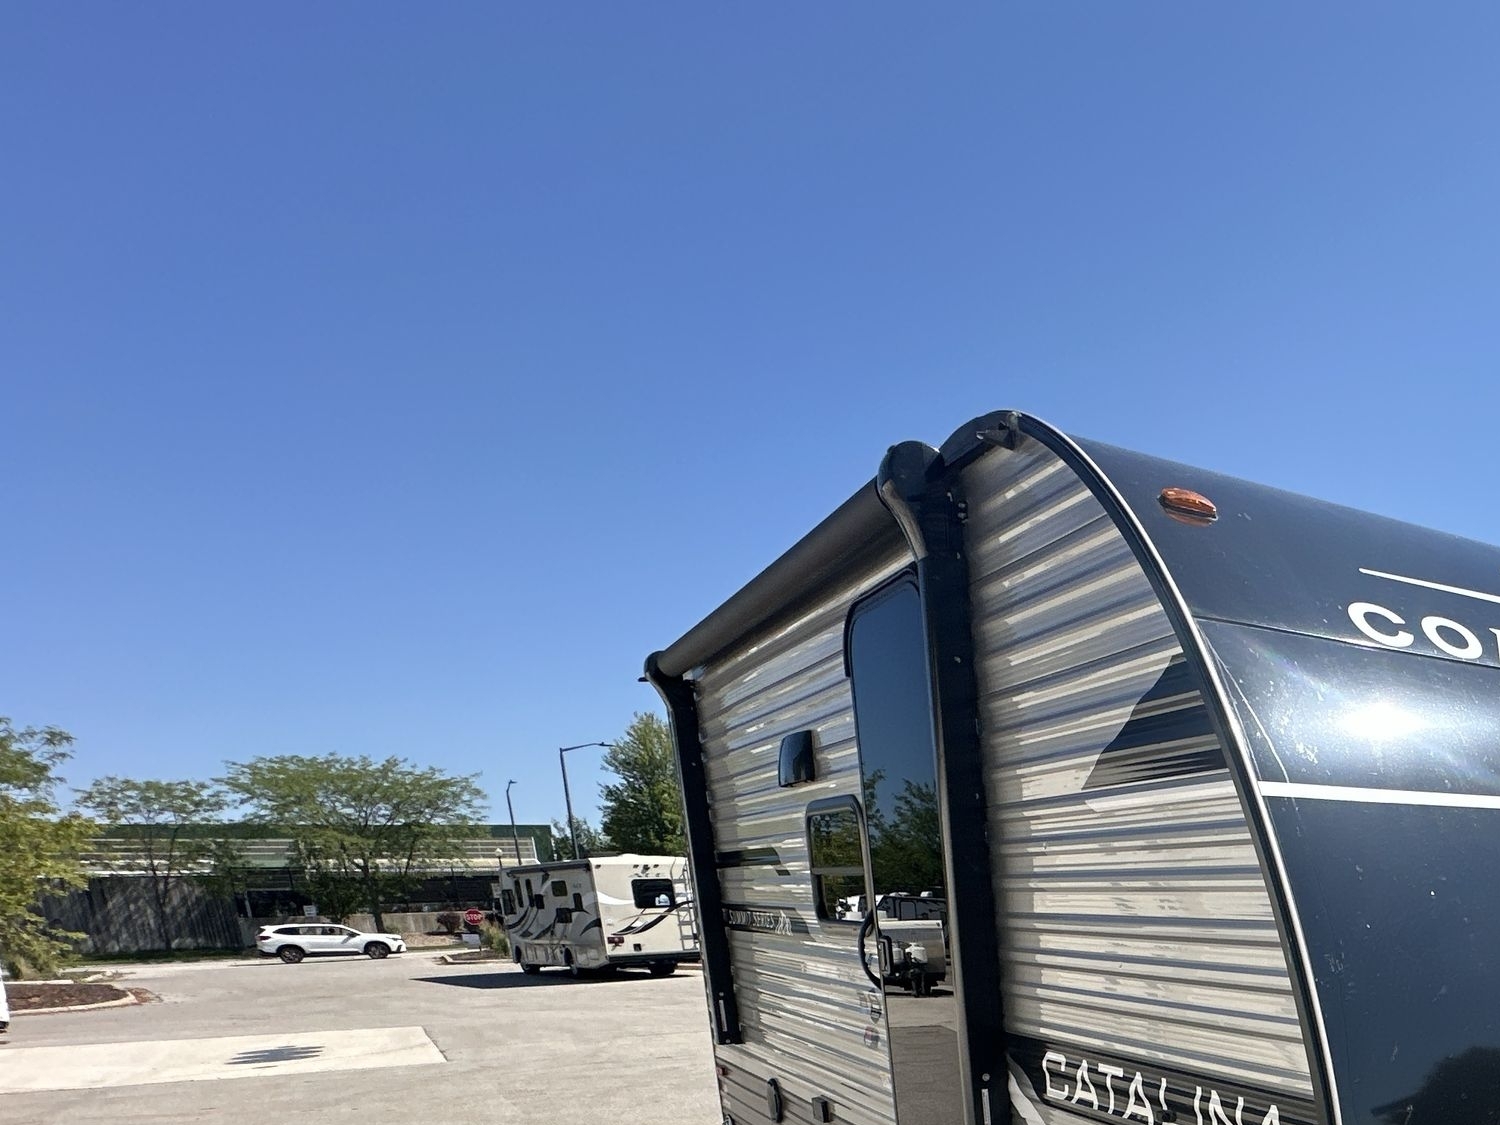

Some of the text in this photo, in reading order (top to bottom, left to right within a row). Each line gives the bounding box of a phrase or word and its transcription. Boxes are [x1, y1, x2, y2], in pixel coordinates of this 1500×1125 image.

[465, 913, 482, 921] STOP
[728, 909, 775, 929] SUMMIT SERIES
